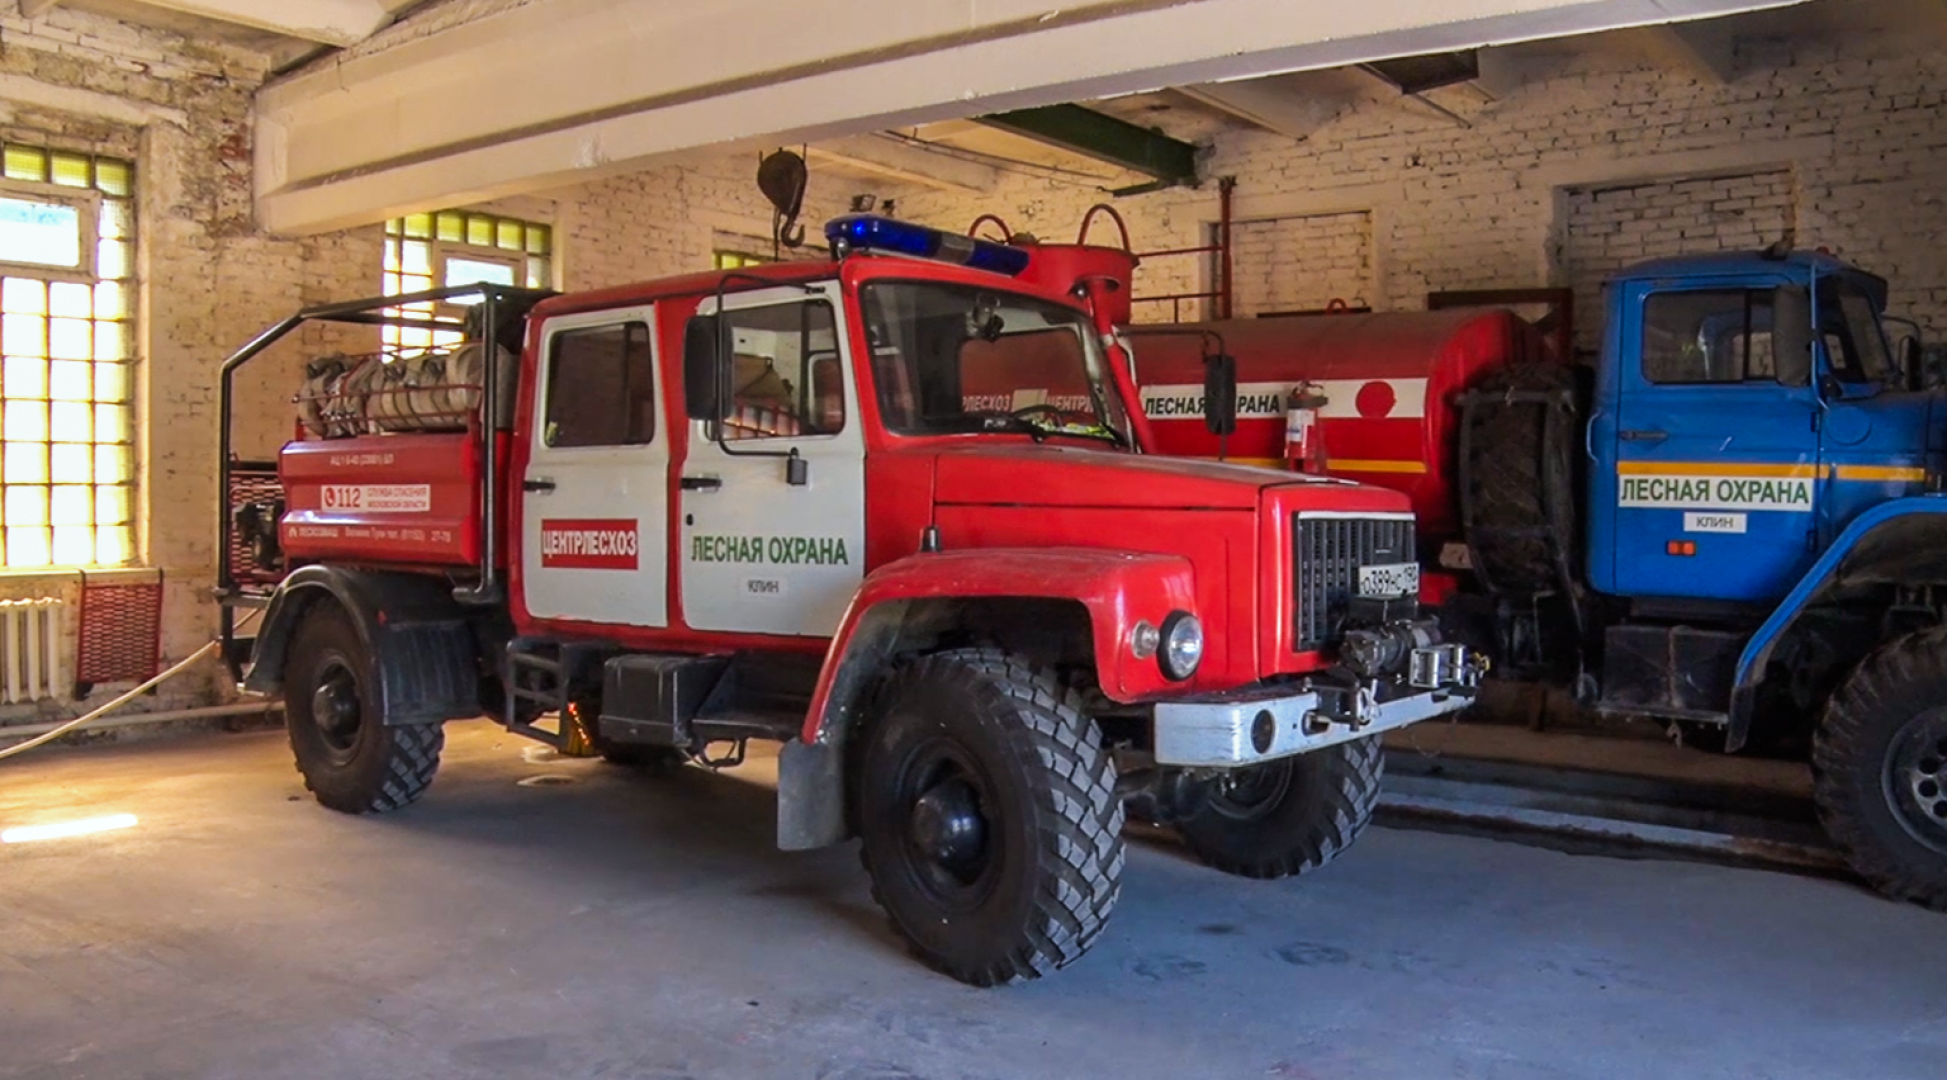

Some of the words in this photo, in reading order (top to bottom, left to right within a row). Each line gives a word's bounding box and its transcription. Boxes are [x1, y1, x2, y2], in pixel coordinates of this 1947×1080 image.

[1145, 397, 1206, 415] ЛЕСНАЯ
[1235, 395, 1280, 413] РАНА
[338, 488, 361, 507] 112
[1621, 479, 1710, 501] ЛЕСНАЯ
[1716, 479, 1809, 504] ОХРАНА
[1696, 516, 1734, 528] КЛИН
[542, 530, 638, 558] ЦЕНТРЛЕСХОЗ
[691, 536, 763, 564] ЛЕСНАЯ
[768, 537, 848, 565] ОХРАНА
[747, 579, 780, 594] КЛИН
